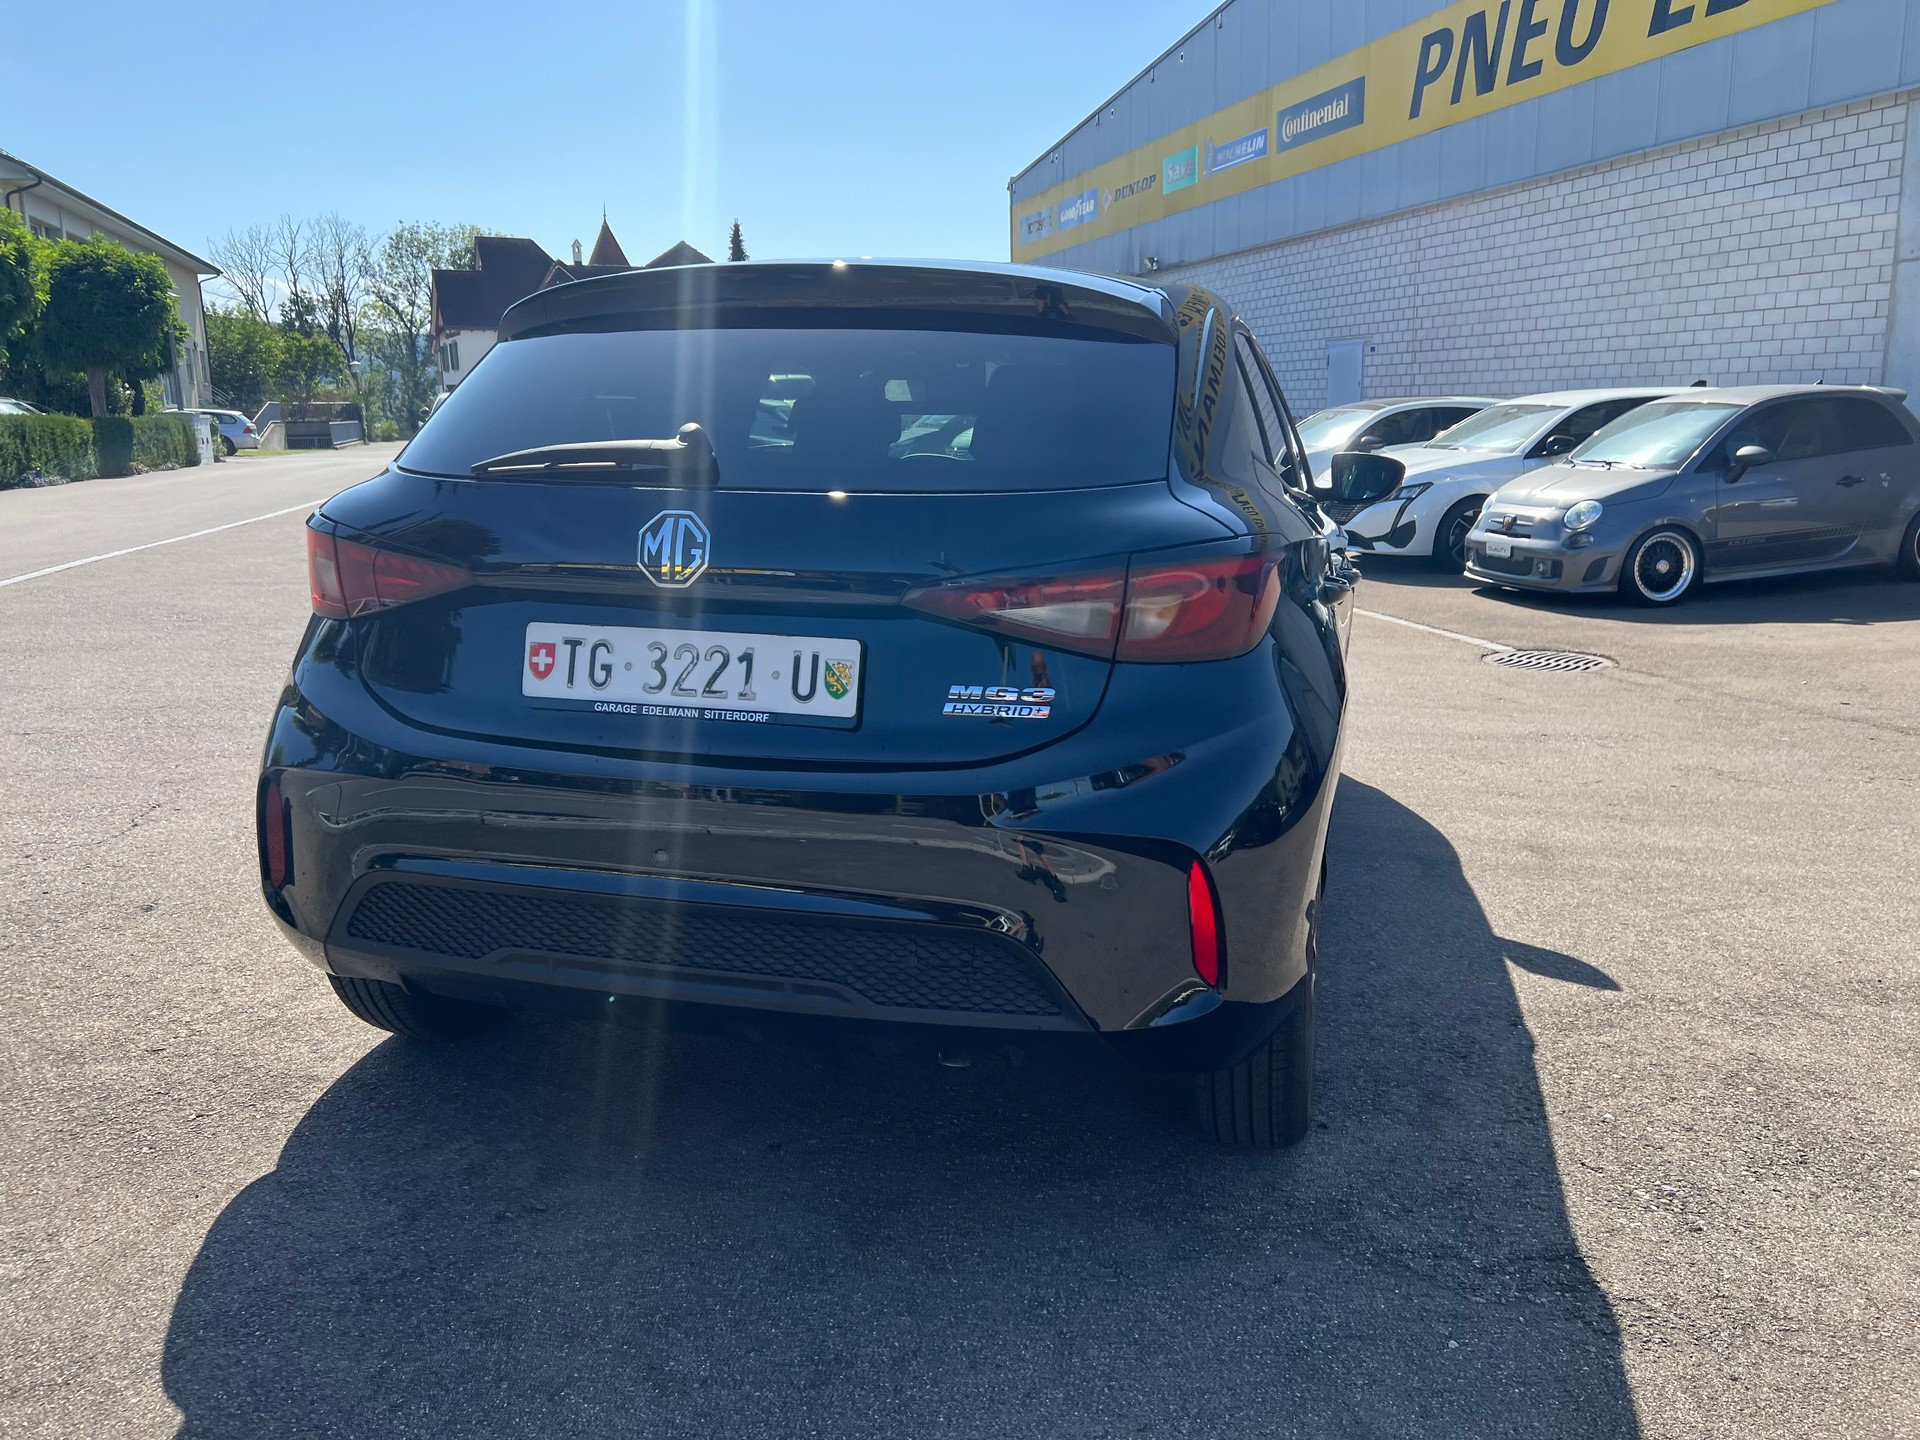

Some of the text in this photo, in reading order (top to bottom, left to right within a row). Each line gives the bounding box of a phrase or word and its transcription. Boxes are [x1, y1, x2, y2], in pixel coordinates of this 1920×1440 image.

[1408, 0, 1611, 120] PNEU
[1281, 93, 1349, 143] Continental
[1216, 134, 1266, 165] MICHELIN
[1113, 174, 1157, 202] DUNLOP
[643, 517, 704, 580] MG
[562, 637, 821, 704] TG 3221 U
[948, 685, 1056, 702] MG3
[594, 702, 770, 723] GARAGE EDELMANN SITTERDORF
[952, 704, 1044, 717] HYBRID+
